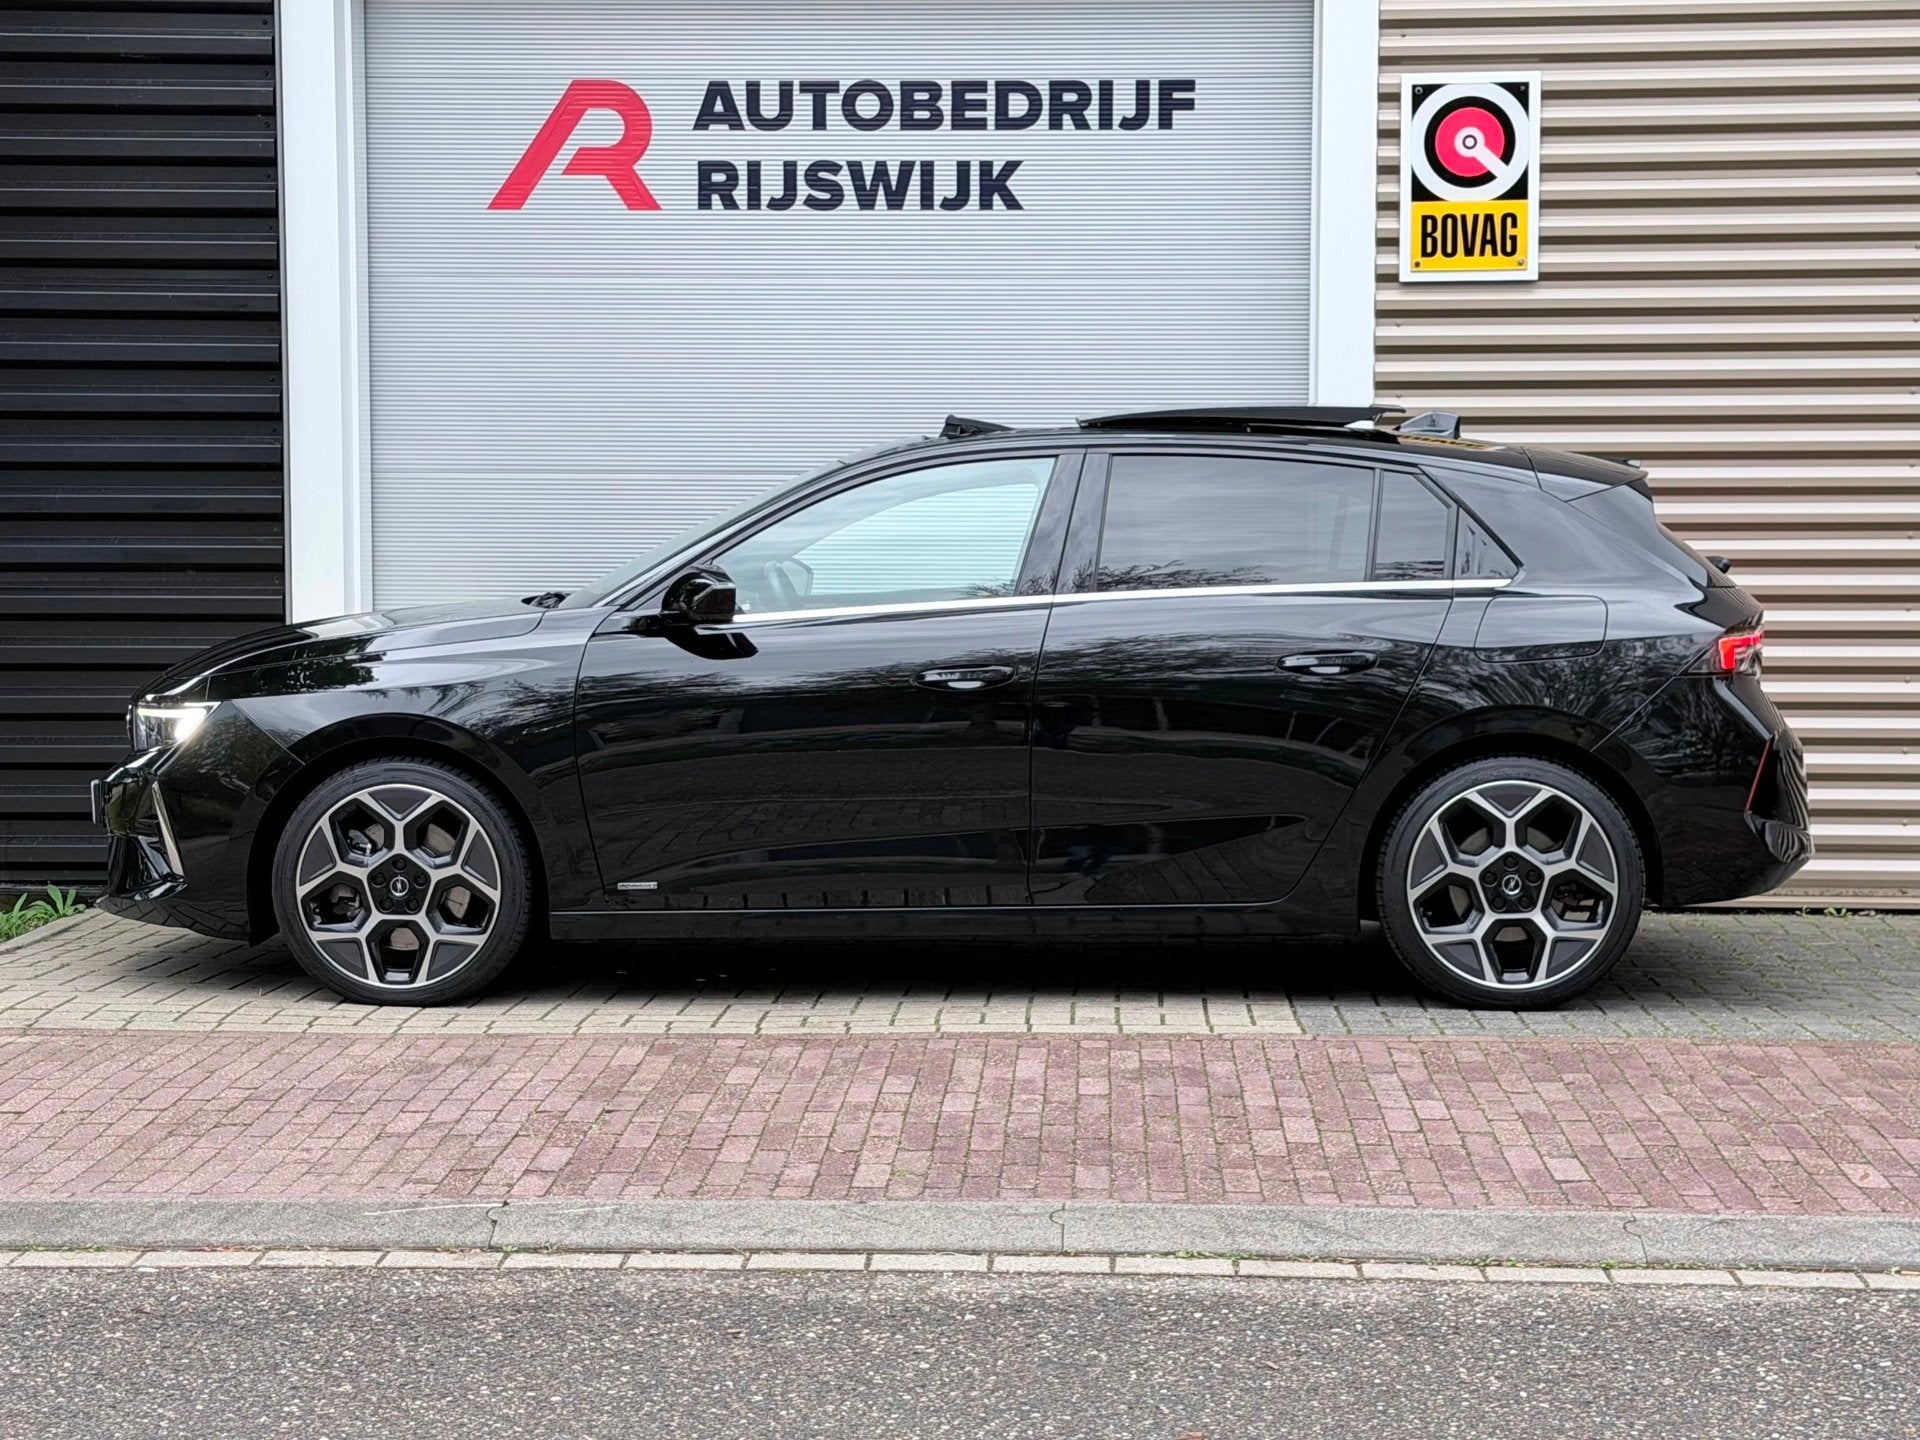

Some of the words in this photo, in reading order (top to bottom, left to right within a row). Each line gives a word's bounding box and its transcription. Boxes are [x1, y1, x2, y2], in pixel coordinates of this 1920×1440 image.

[692, 79, 1196, 132] AUTOBEDRIJF
[697, 159, 1024, 211] RIJSWIJK
[1420, 212, 1518, 259] BOVAG
